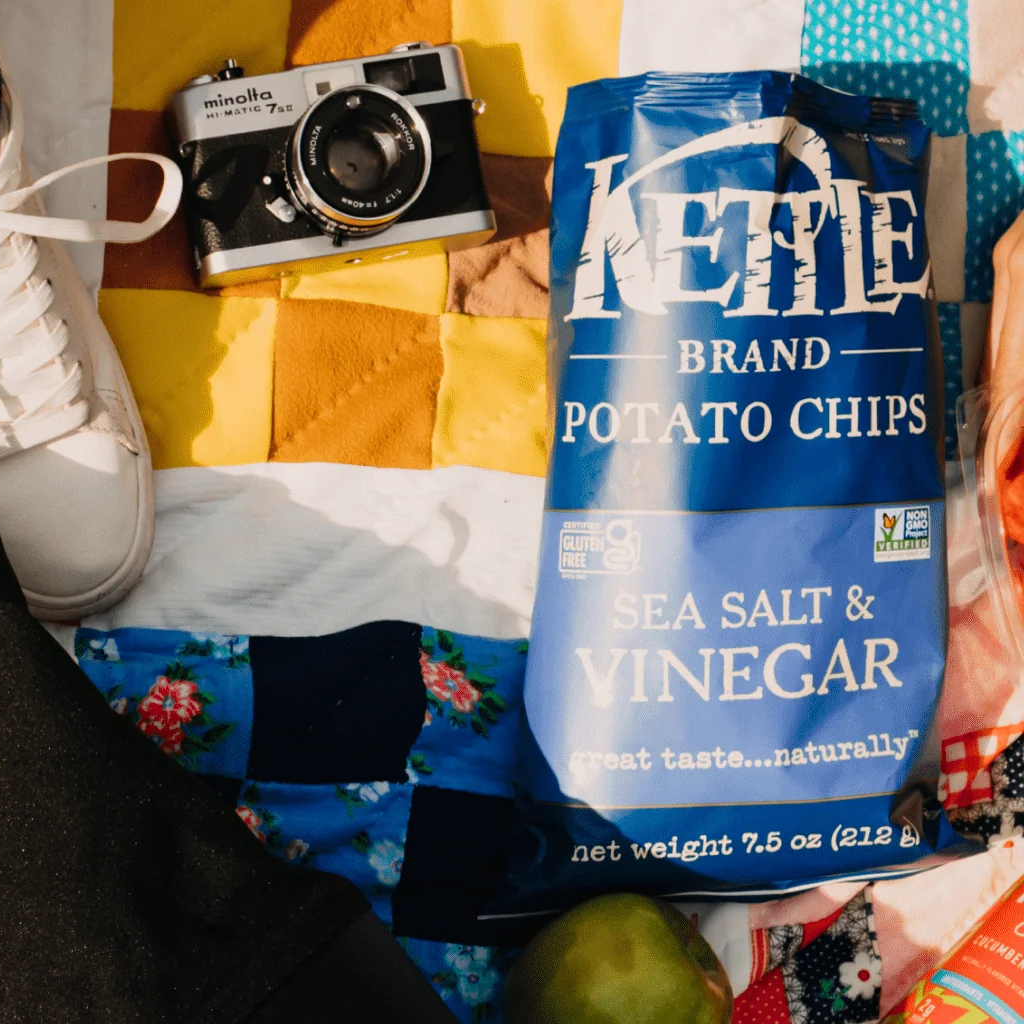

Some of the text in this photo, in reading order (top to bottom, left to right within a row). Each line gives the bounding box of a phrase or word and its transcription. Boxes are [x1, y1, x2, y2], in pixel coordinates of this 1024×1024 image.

[204, 87, 273, 109] minolta
[309, 125, 322, 166] MINOLTA
[390, 112, 415, 151] ROKKOR
[563, 116, 932, 322] KETTLE
[676, 336, 831, 375] BRAND
[561, 393, 927, 444] POTATO CHIPS
[906, 510, 928, 521] NON
[906, 519, 928, 531] GMO
[563, 535, 605, 552] GLUTEN
[879, 539, 928, 551] VERIFIED
[562, 551, 587, 568] FREE
[612, 583, 876, 631] SEA SALT &
[574, 637, 904, 708] VINEGAR
[568, 747, 652, 774] great
[571, 840, 621, 863] net
[631, 834, 733, 862] weight
[742, 831, 782, 854] 7.5
[790, 833, 822, 851] oz
[918, 998, 936, 1018] 2g
